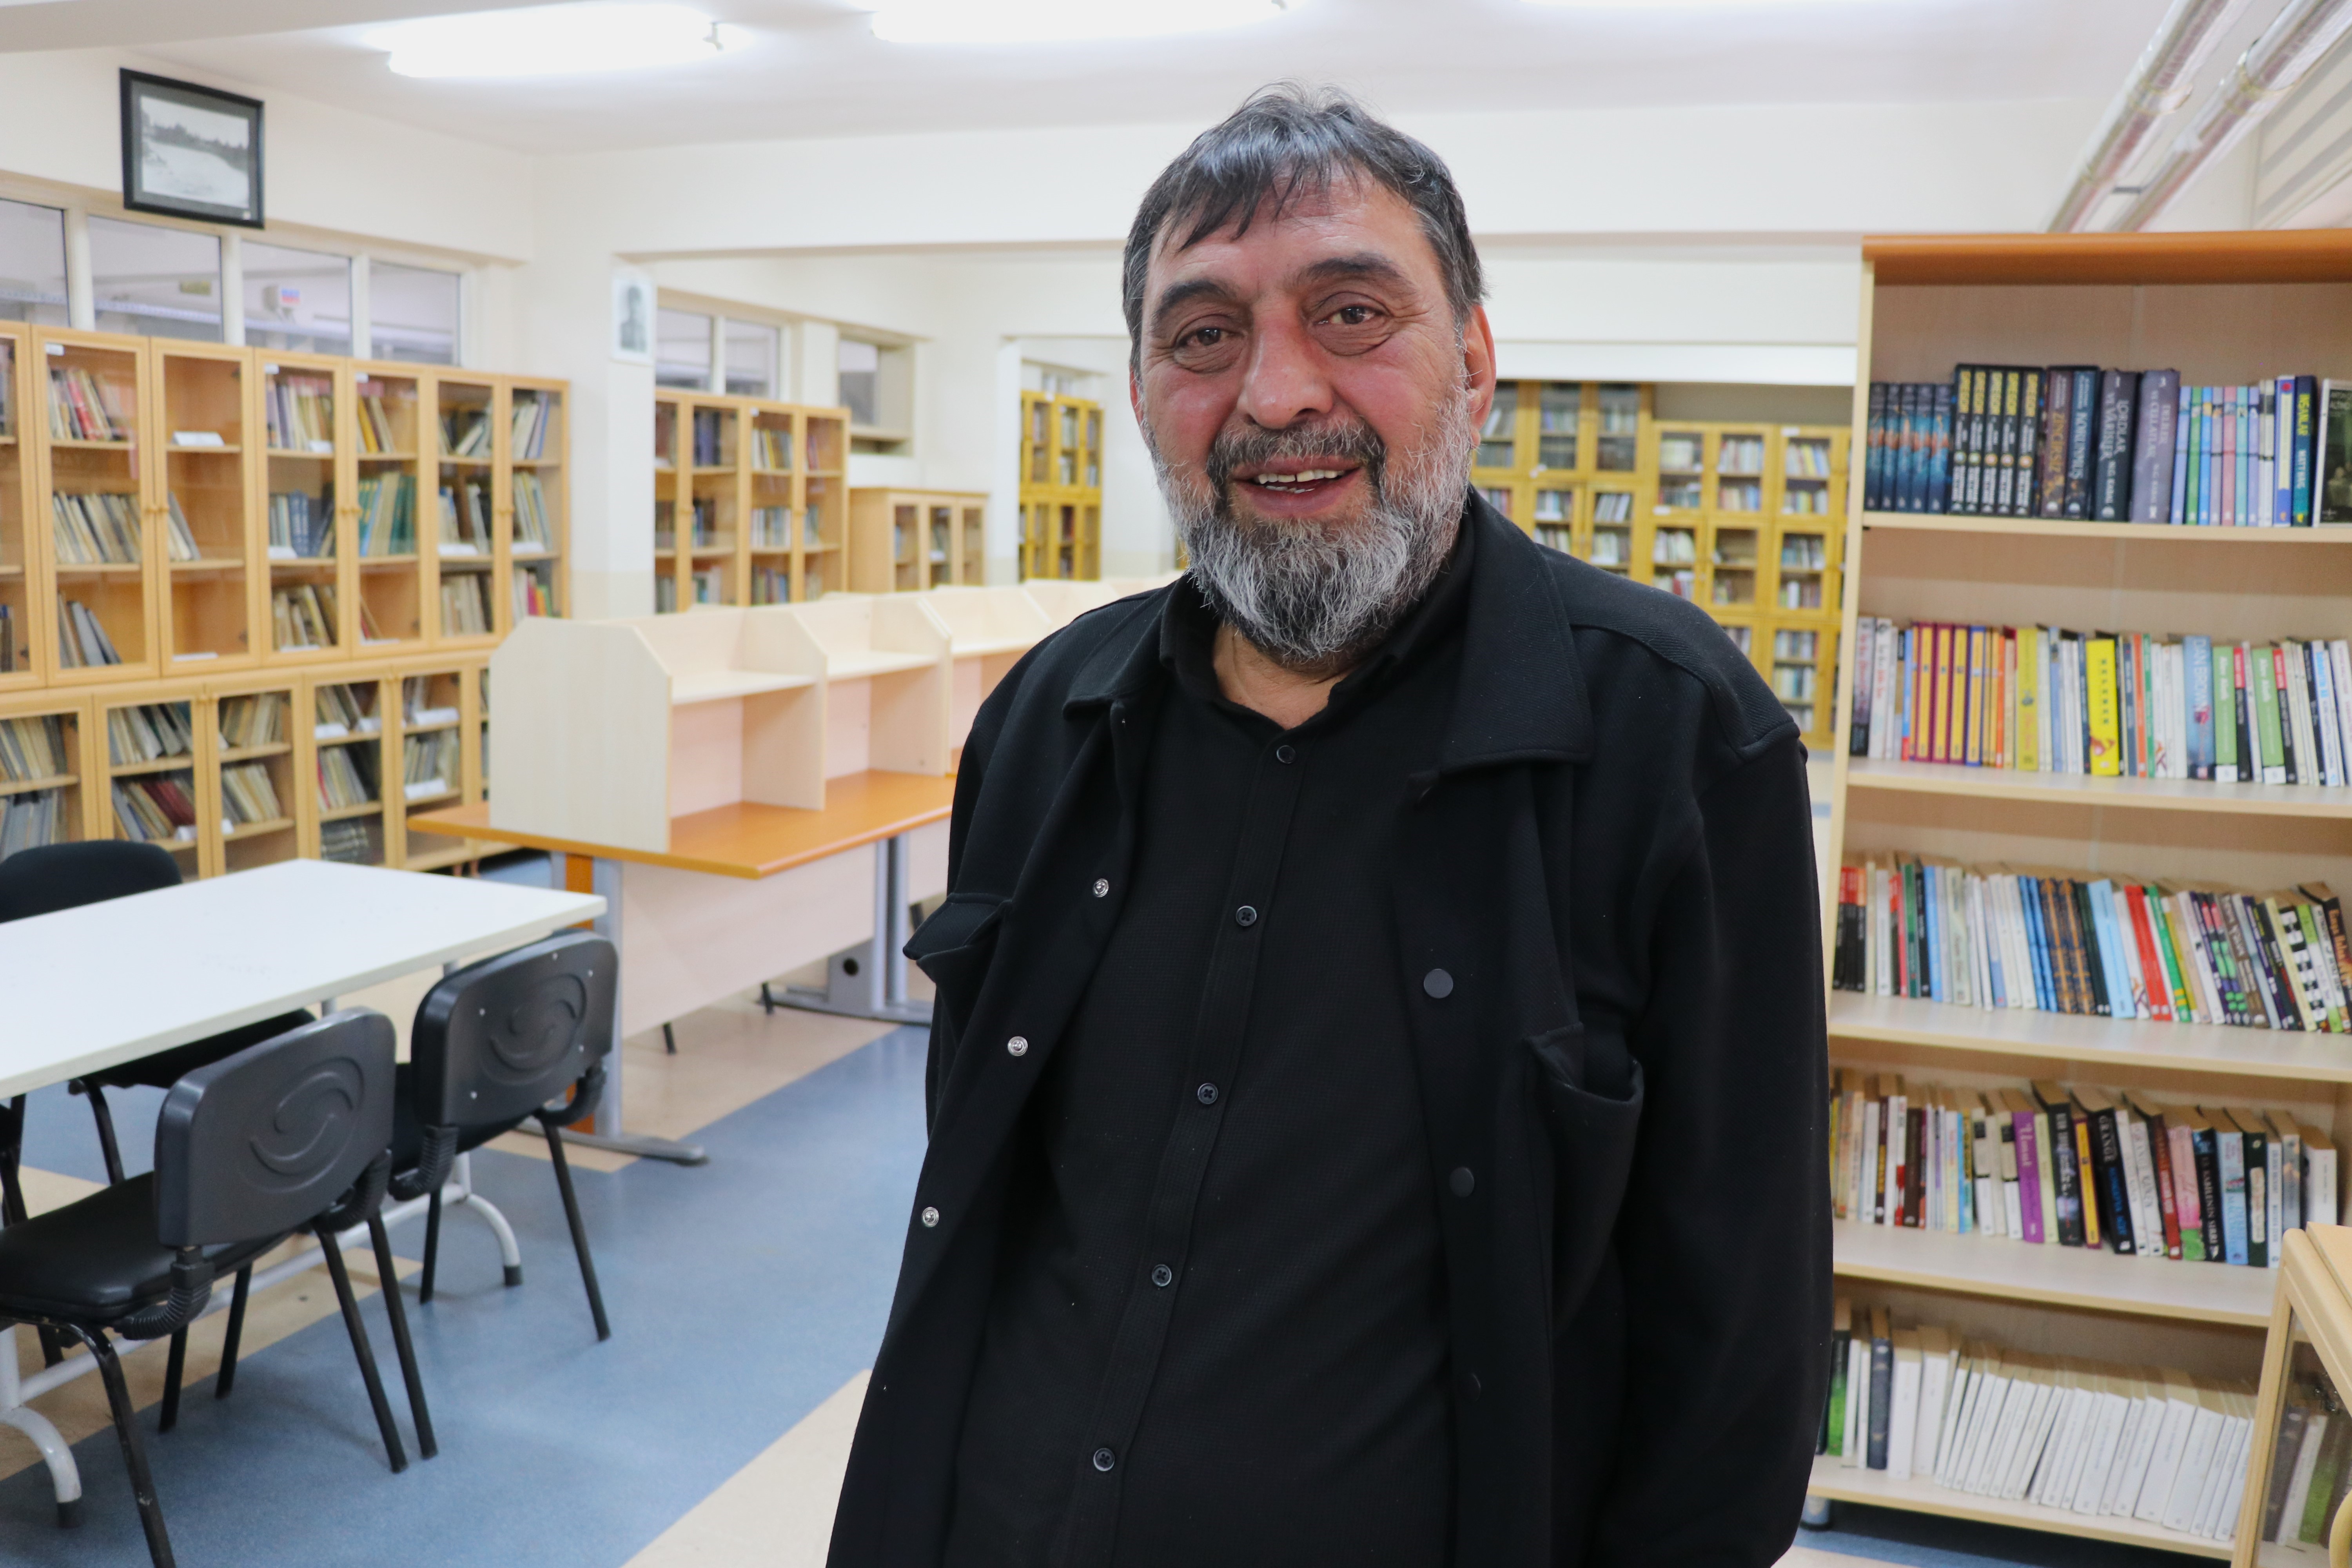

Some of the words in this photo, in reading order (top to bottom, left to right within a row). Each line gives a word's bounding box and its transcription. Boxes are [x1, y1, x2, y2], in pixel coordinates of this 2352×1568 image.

[2113, 399, 2129, 455] LORDLAR
[2193, 638, 2207, 665] DAN
[2193, 666, 2209, 711] BROWN
[2202, 1170, 2216, 1218] KABİLENİN
[2207, 1220, 2218, 1243] SIRRI
